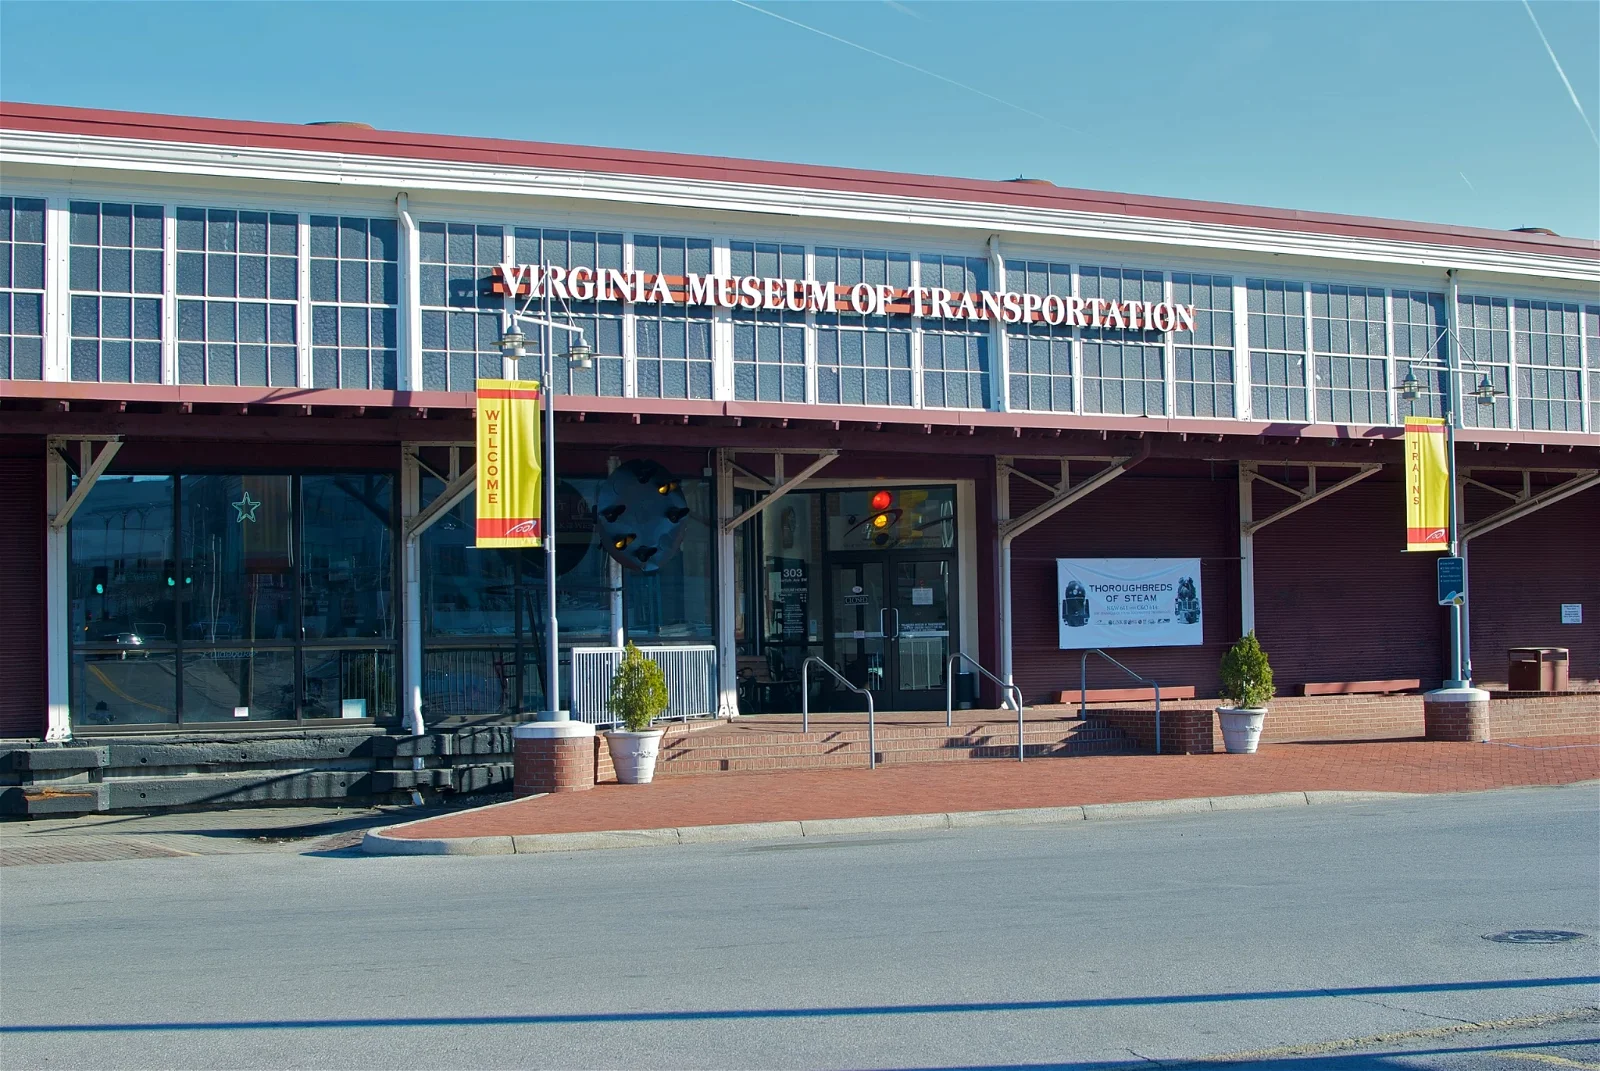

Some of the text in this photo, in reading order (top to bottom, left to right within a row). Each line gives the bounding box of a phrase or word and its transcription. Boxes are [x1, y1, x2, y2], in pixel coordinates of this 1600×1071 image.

[498, 262, 1196, 335] VIRGINIA MUSEUM OF TRANSPORTATION
[485, 410, 500, 504] WELCOME
[1412, 441, 1420, 505] TRAINS
[783, 568, 803, 578] 303
[1088, 583, 1173, 593] THOROUGHBREDS
[1105, 594, 1157, 603] OF STEAM
